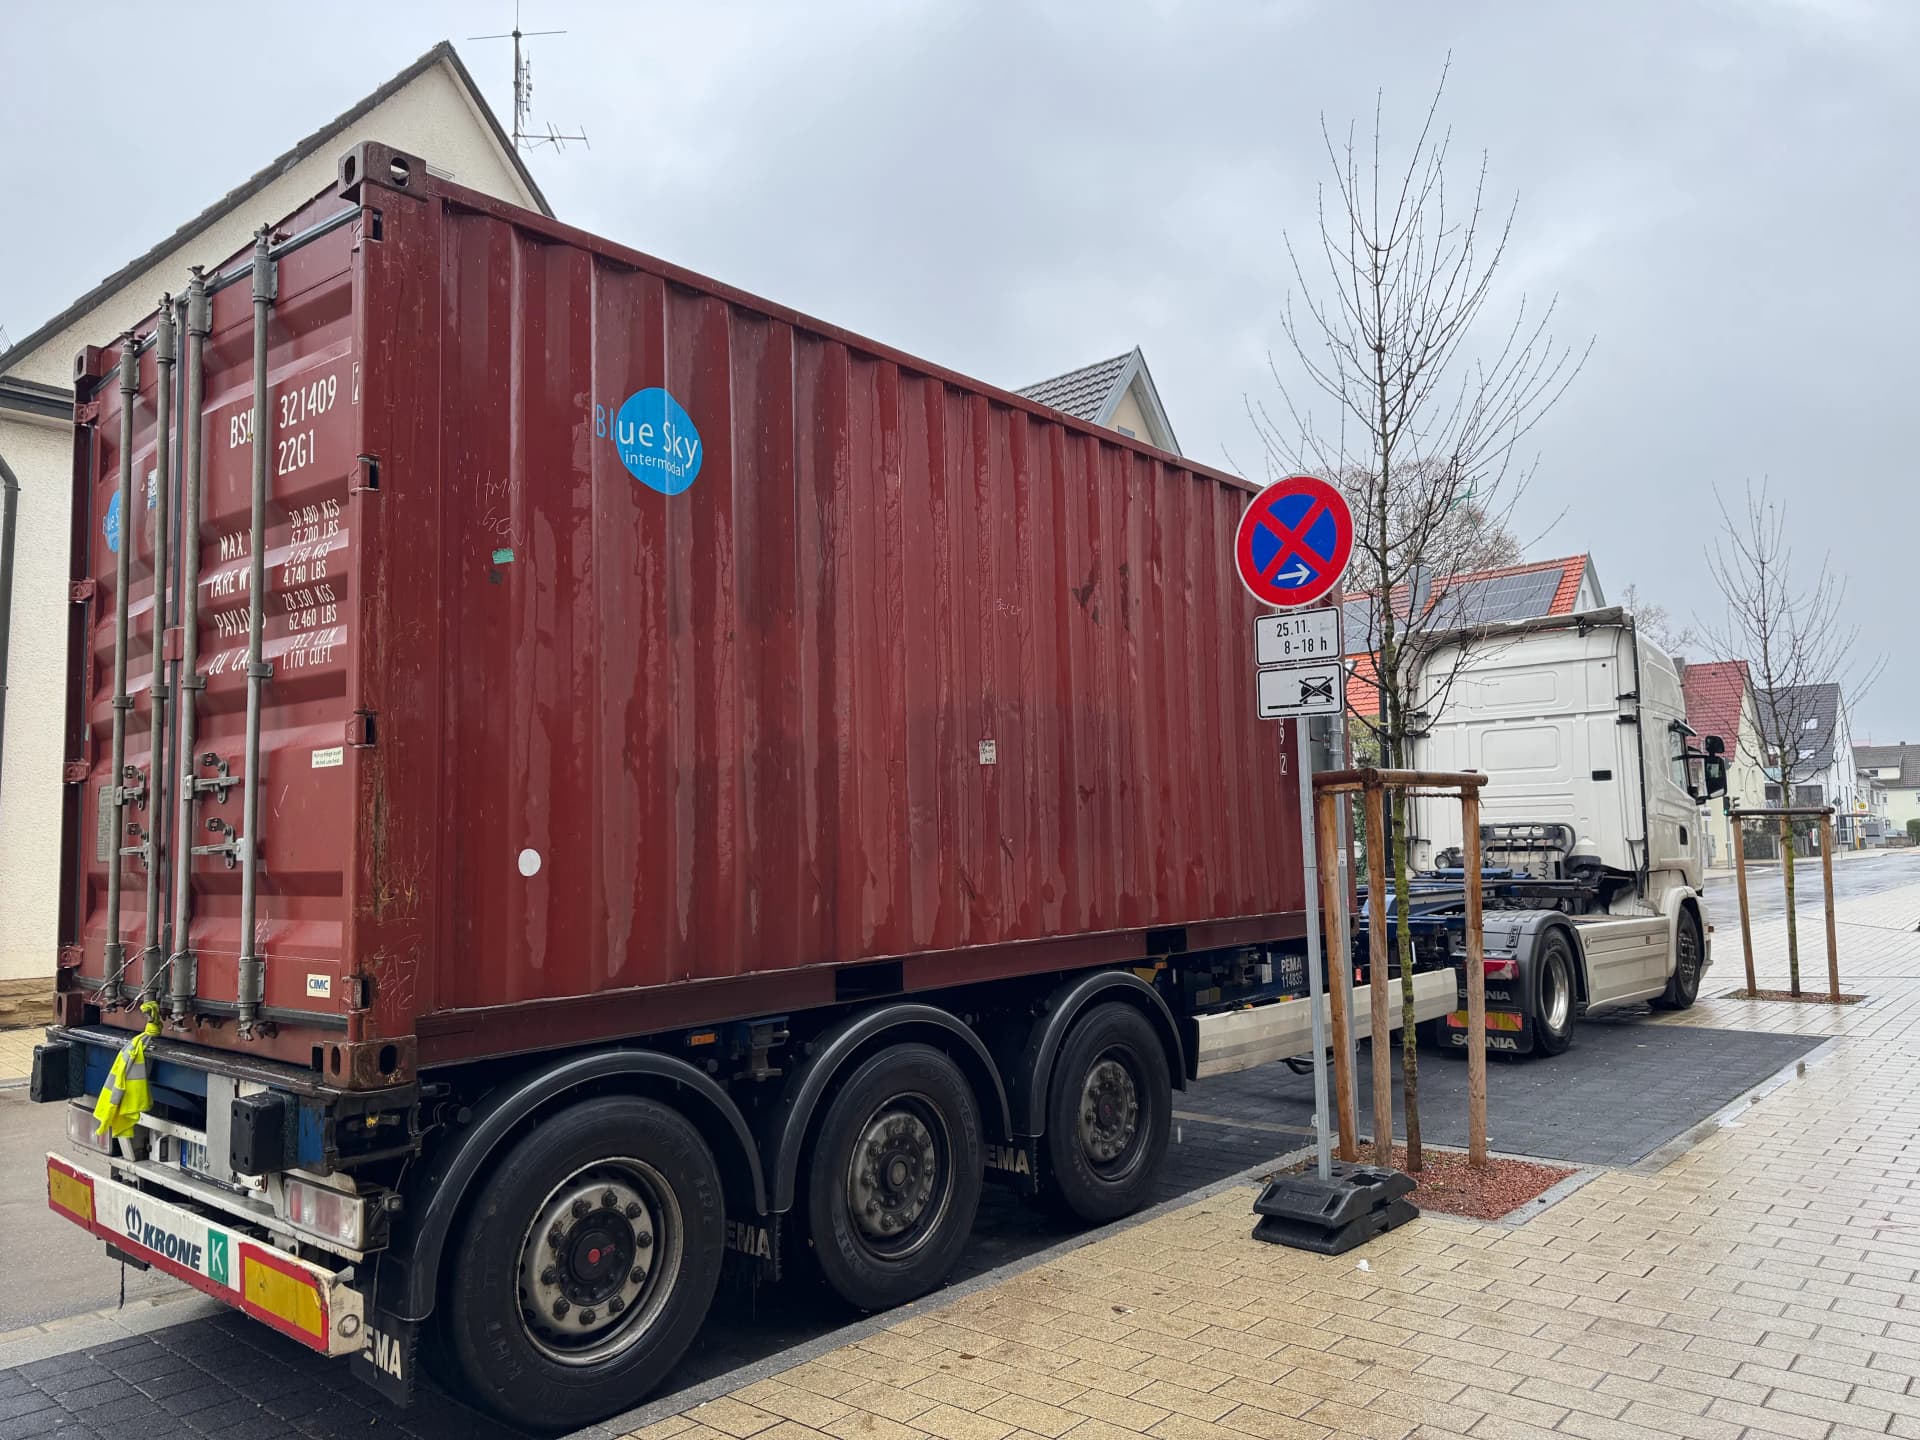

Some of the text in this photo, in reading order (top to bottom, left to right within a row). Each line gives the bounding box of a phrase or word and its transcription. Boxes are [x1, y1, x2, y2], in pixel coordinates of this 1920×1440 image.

[280, 375, 336, 428] 321409
[596, 404, 698, 469] Blue Sky
[279, 429, 314, 475] 22G1
[625, 450, 685, 477] intermodal
[289, 498, 340, 528] 30.480 KGS
[322, 519, 339, 539] LBS
[210, 569, 239, 598] TARE
[283, 559, 326, 586] 4.740 LBS
[282, 583, 335, 610] 28.330 KGS
[321, 604, 336, 624] LBS
[1276, 619, 1310, 637] 25.11.
[1320, 636, 1327, 651] h
[1281, 956, 1302, 973] PEMA
[309, 978, 328, 990] CIMC
[1458, 988, 1511, 1000] SNIA
[143, 1222, 223, 1276] KRONE K
